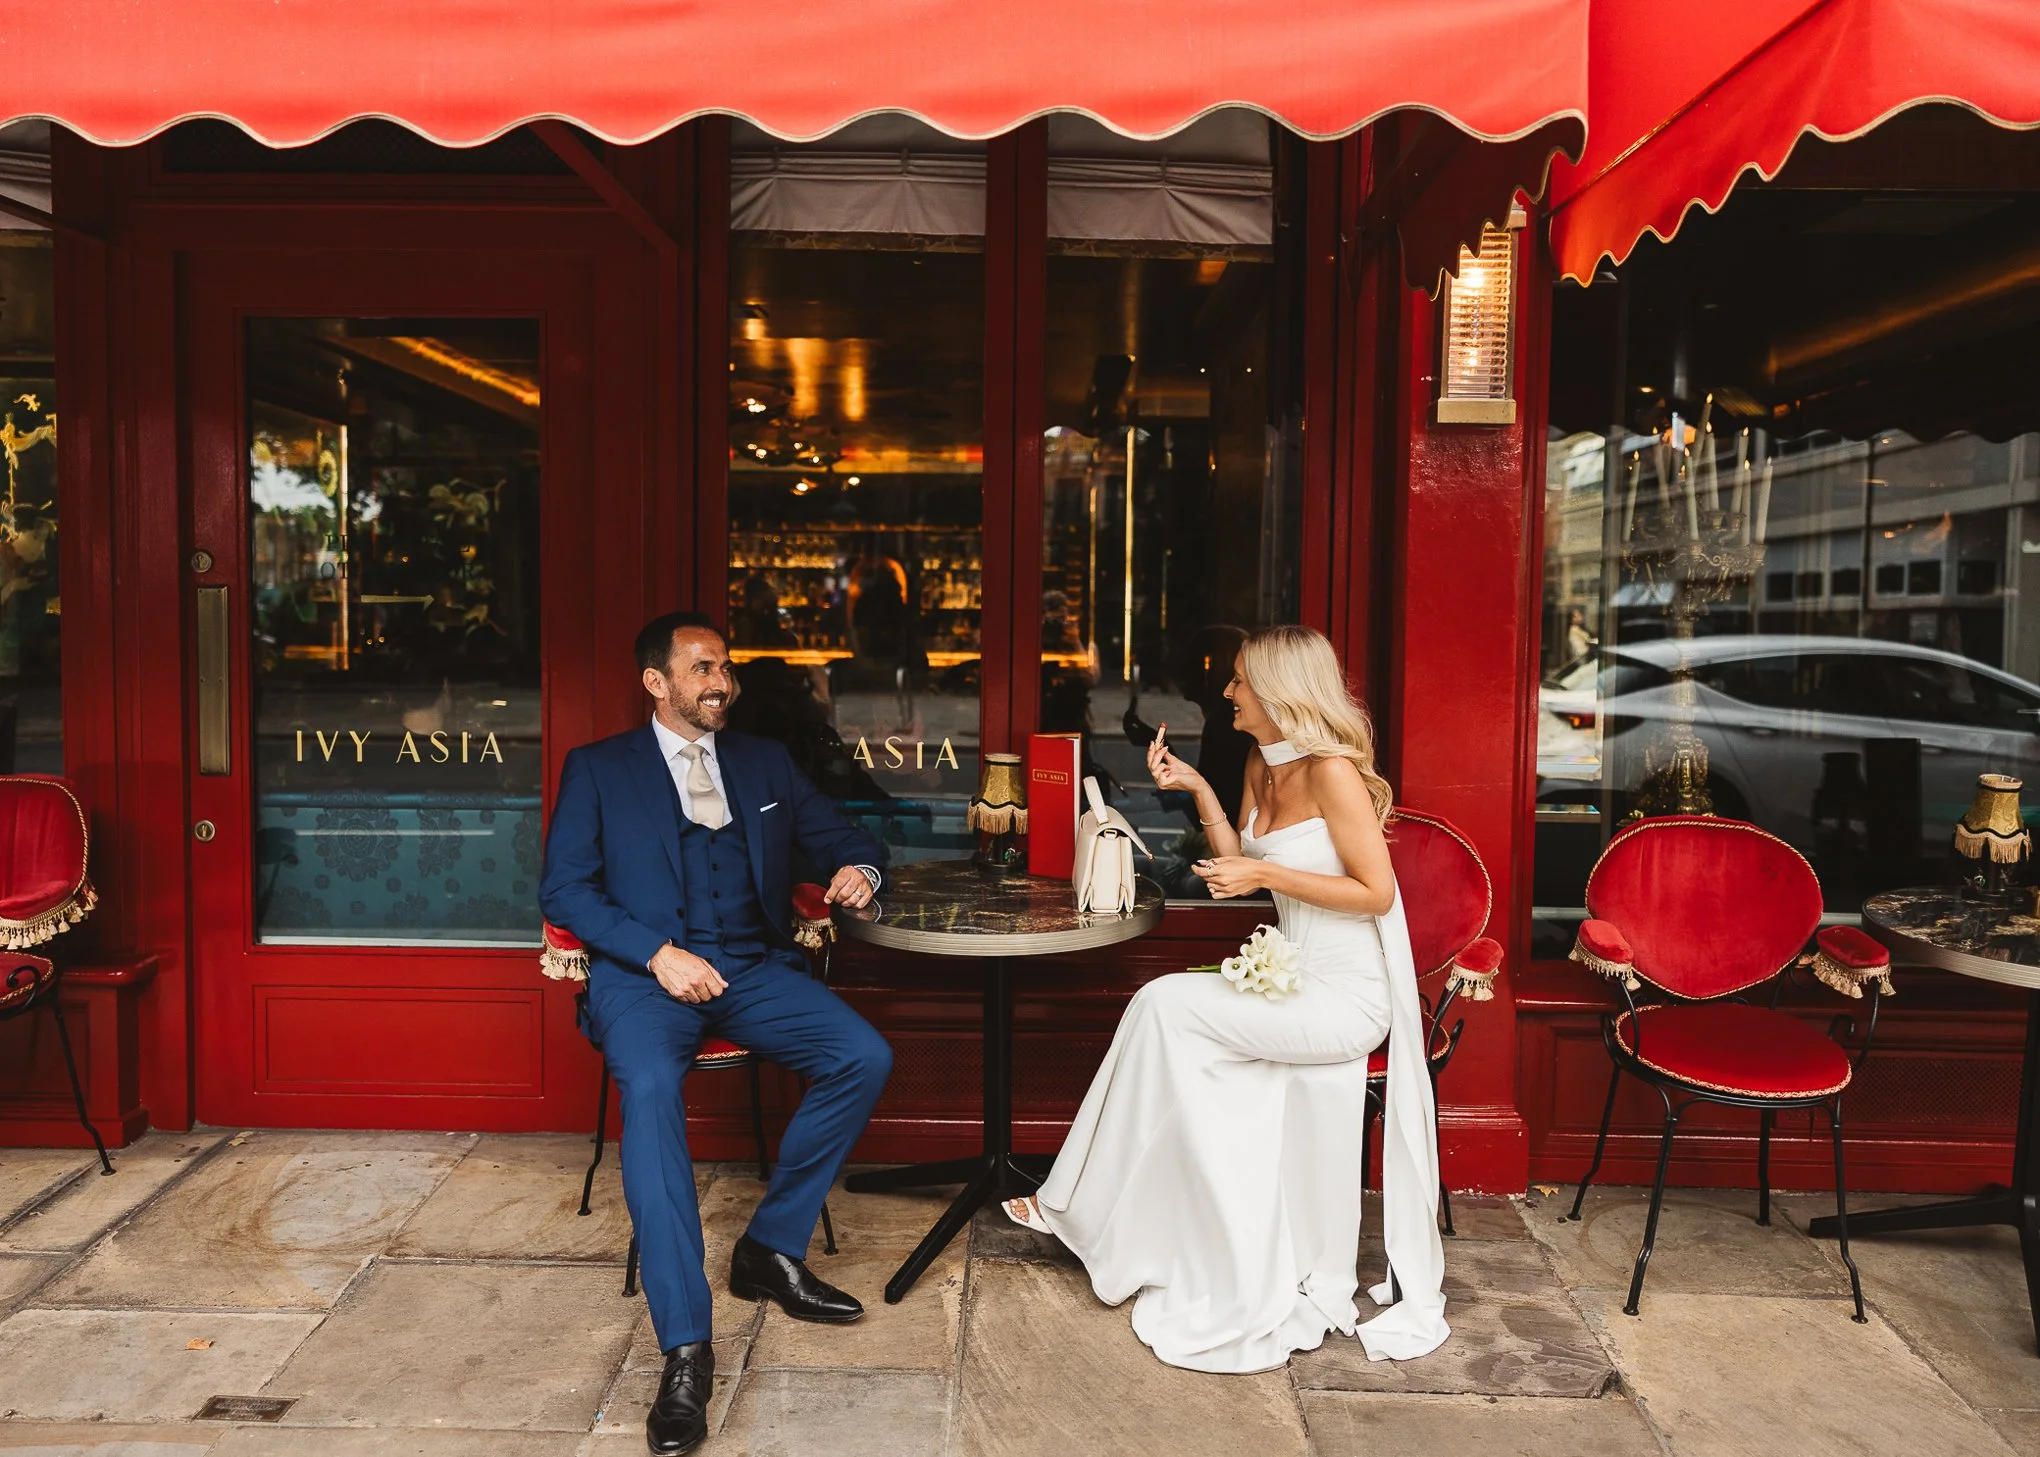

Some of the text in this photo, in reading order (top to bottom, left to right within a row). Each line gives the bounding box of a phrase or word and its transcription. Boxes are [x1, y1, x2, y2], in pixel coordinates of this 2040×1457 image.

[296, 730, 504, 763] IVY ASIA
[853, 736, 959, 770] ASIA
